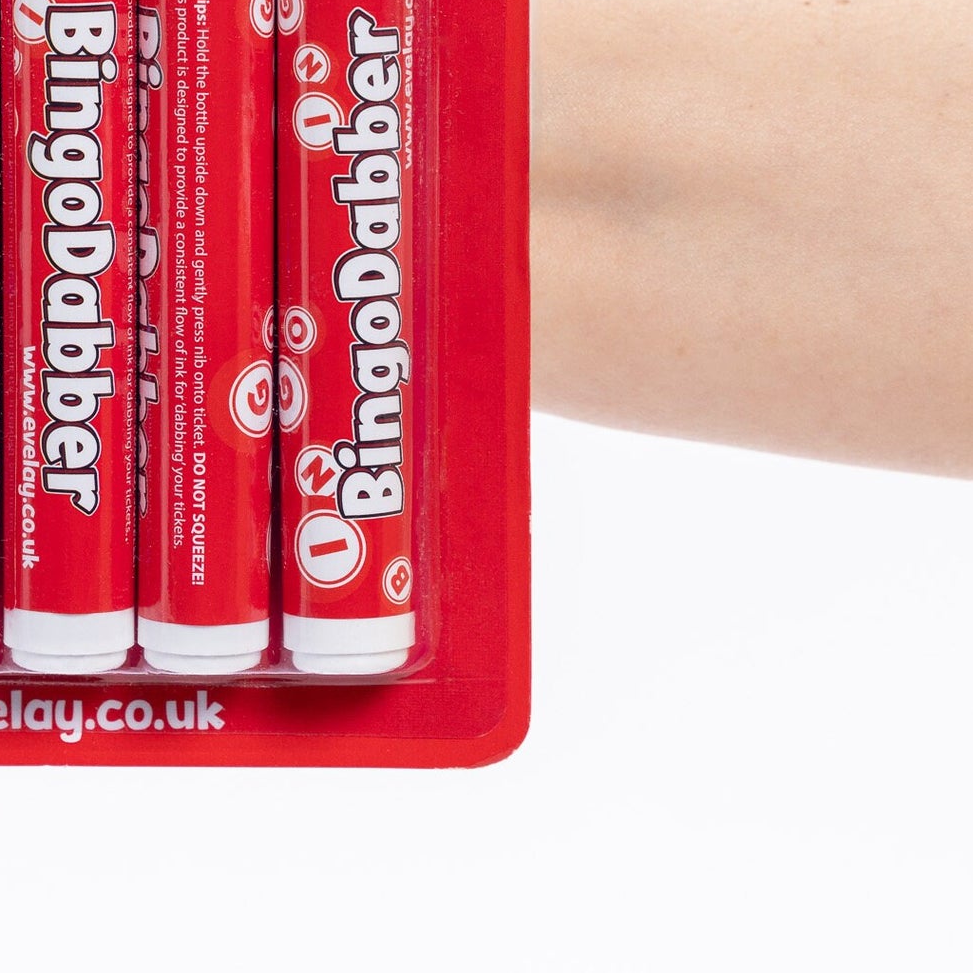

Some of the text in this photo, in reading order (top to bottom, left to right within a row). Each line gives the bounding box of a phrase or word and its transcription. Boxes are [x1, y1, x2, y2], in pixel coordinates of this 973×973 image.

[175, 7, 190, 62] product
[196, 29, 209, 62] Hold
[127, 55, 134, 65] is
[177, 66, 189, 76] is
[196, 65, 209, 88] the
[126, 68, 134, 131] designed
[174, 80, 189, 144] designed
[196, 92, 209, 133] bottle
[127, 135, 134, 149] to
[176, 147, 187, 161] to
[193, 137, 208, 183] upside
[126, 153, 134, 205] provide
[174, 165, 189, 218] provide
[127, 209, 134, 217] a
[195, 187, 208, 226] down
[26, 2, 119, 516] BingoDabber
[195, 229, 208, 256] and
[175, 233, 188, 303] consistent
[331, 7, 411, 519] BingoDabber
[191, 259, 207, 303] gently
[127, 326, 134, 340] of
[175, 307, 188, 336] flow
[192, 307, 204, 342] press
[175, 339, 188, 355] of
[194, 347, 207, 368] nib
[175, 357, 187, 378] ink
[175, 382, 187, 400] for
[194, 372, 206, 404] onto
[193, 408, 207, 448] ticket.
[18, 345, 40, 569] www.evelay.co.uk
[193, 452, 205, 475] DO
[172, 467, 183, 499] your
[193, 479, 205, 510] NOT
[173, 502, 186, 549] tickets.
[191, 513, 205, 586] SQUEEZE!
